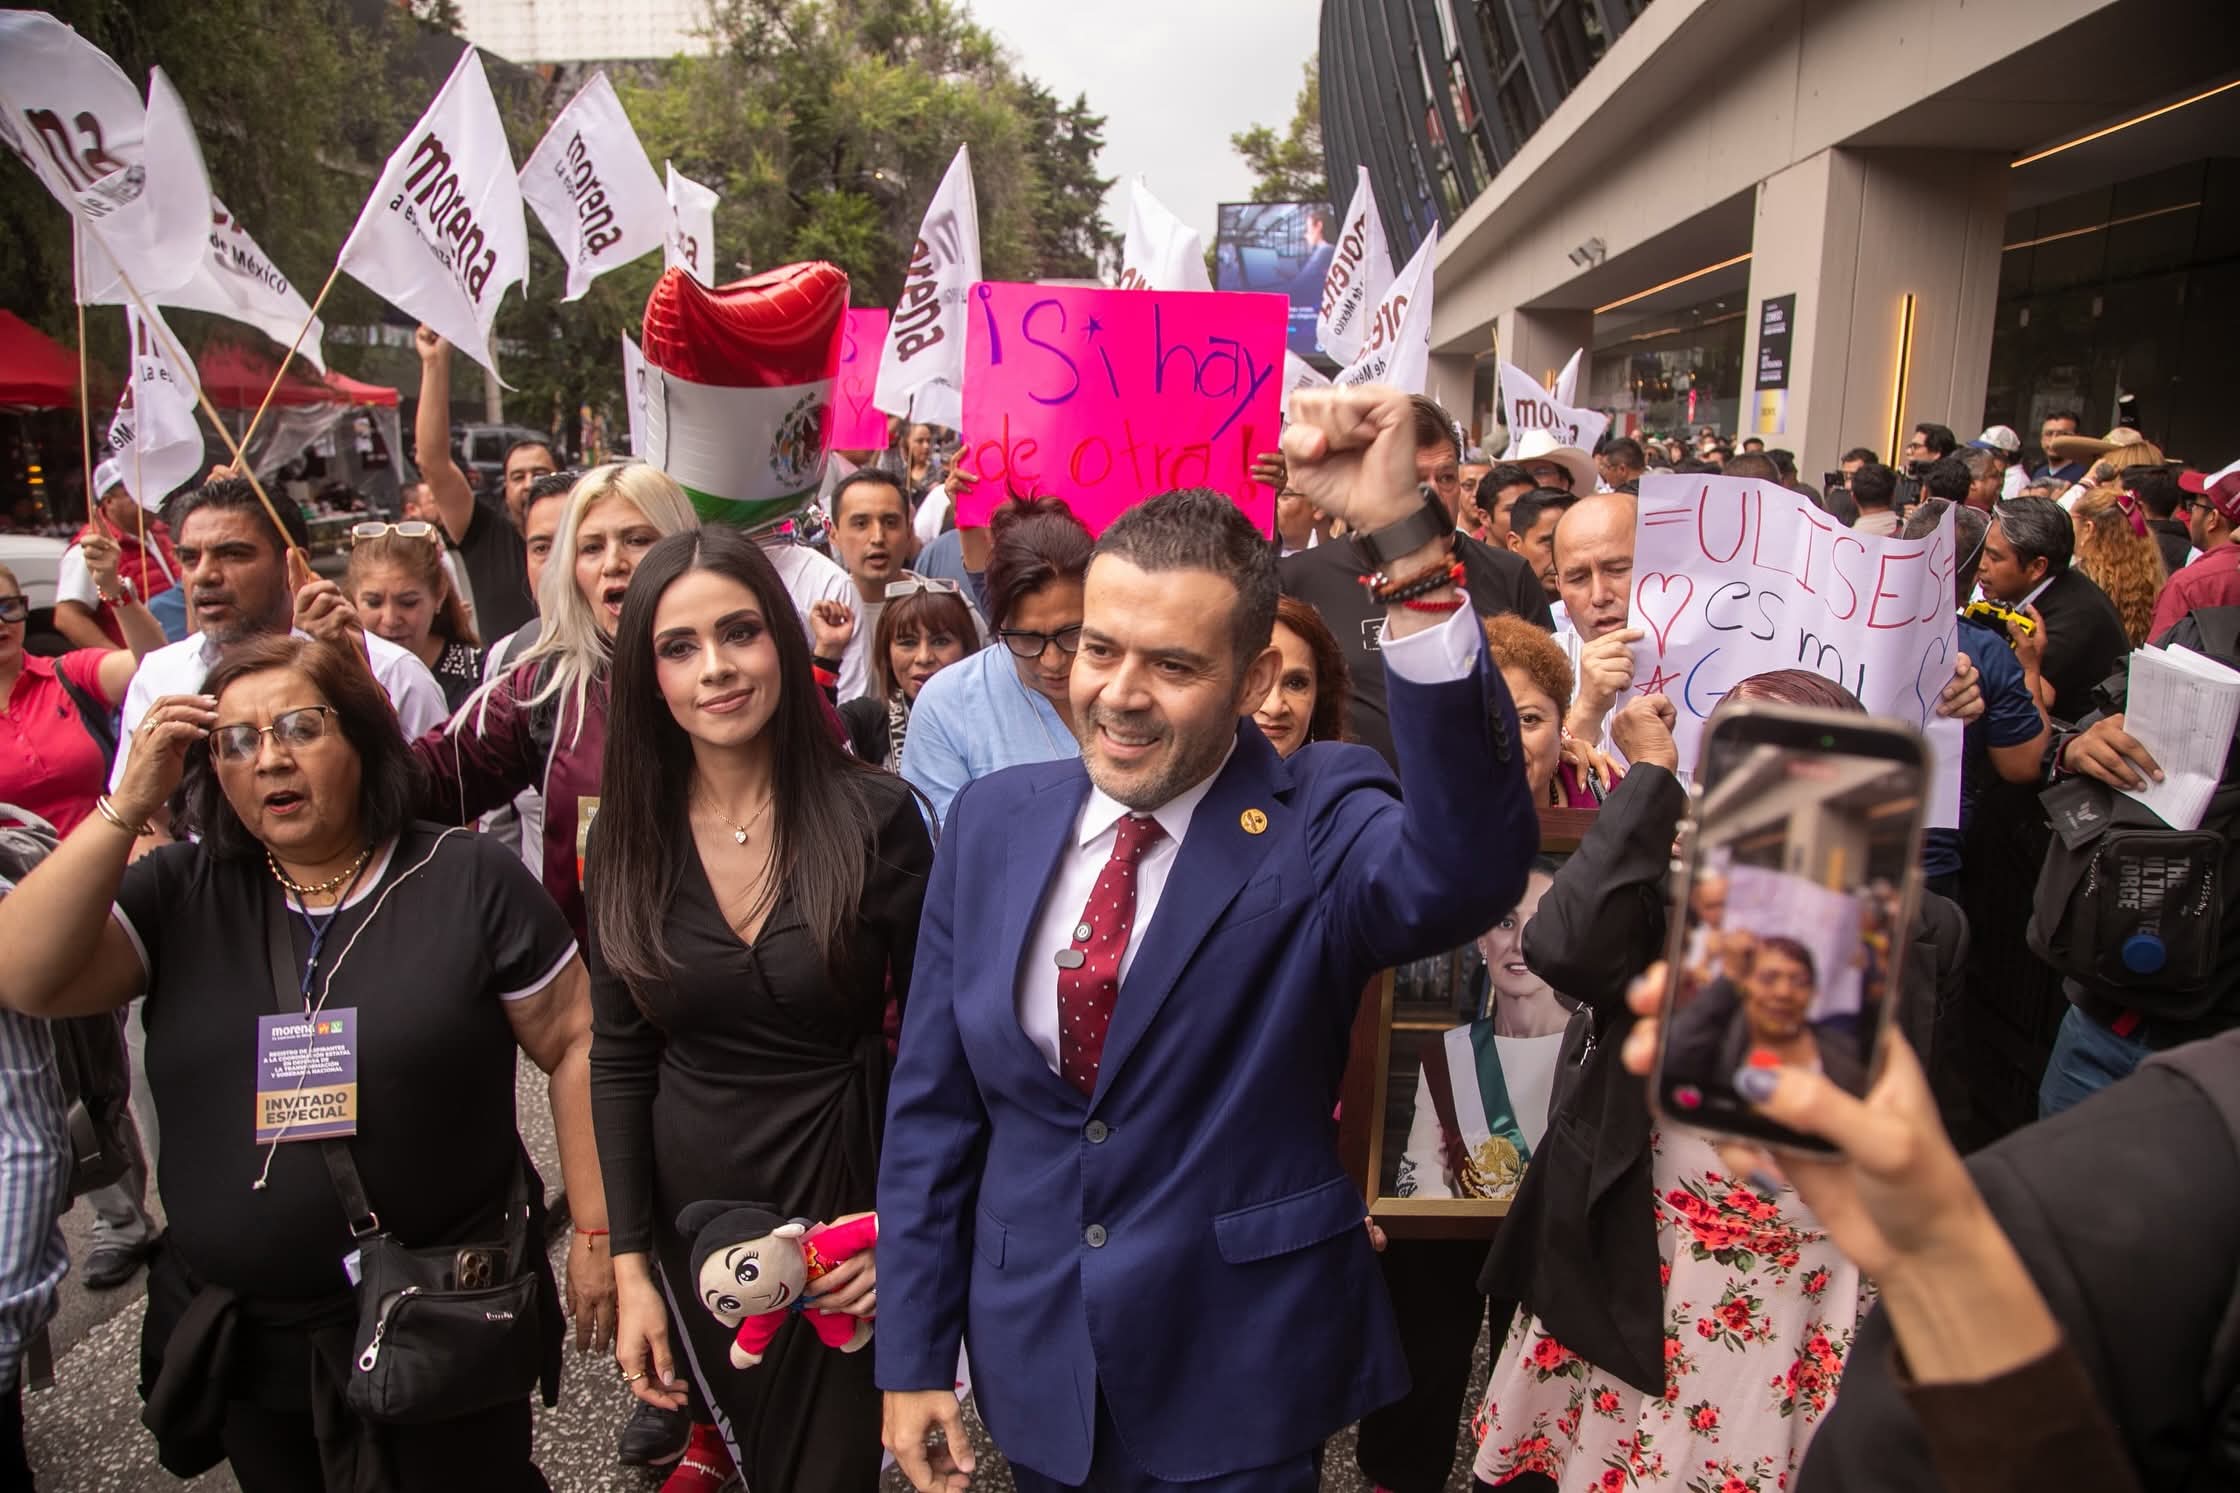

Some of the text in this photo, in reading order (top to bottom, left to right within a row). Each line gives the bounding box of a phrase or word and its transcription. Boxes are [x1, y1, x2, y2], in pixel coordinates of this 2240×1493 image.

[405, 131, 496, 303] morena
[566, 131, 622, 256] morena
[209, 232, 288, 296] de México
[895, 238, 945, 362] orena
[1154, 303, 1273, 441] hay
[975, 413, 1040, 483] de
[2118, 855, 2141, 910] FORCE
[2137, 857, 2165, 936] ULTIMTE
[2167, 856, 2190, 889] THE
[271, 1024, 316, 1037] morena
[265, 1105, 347, 1124] ESPECIAL
